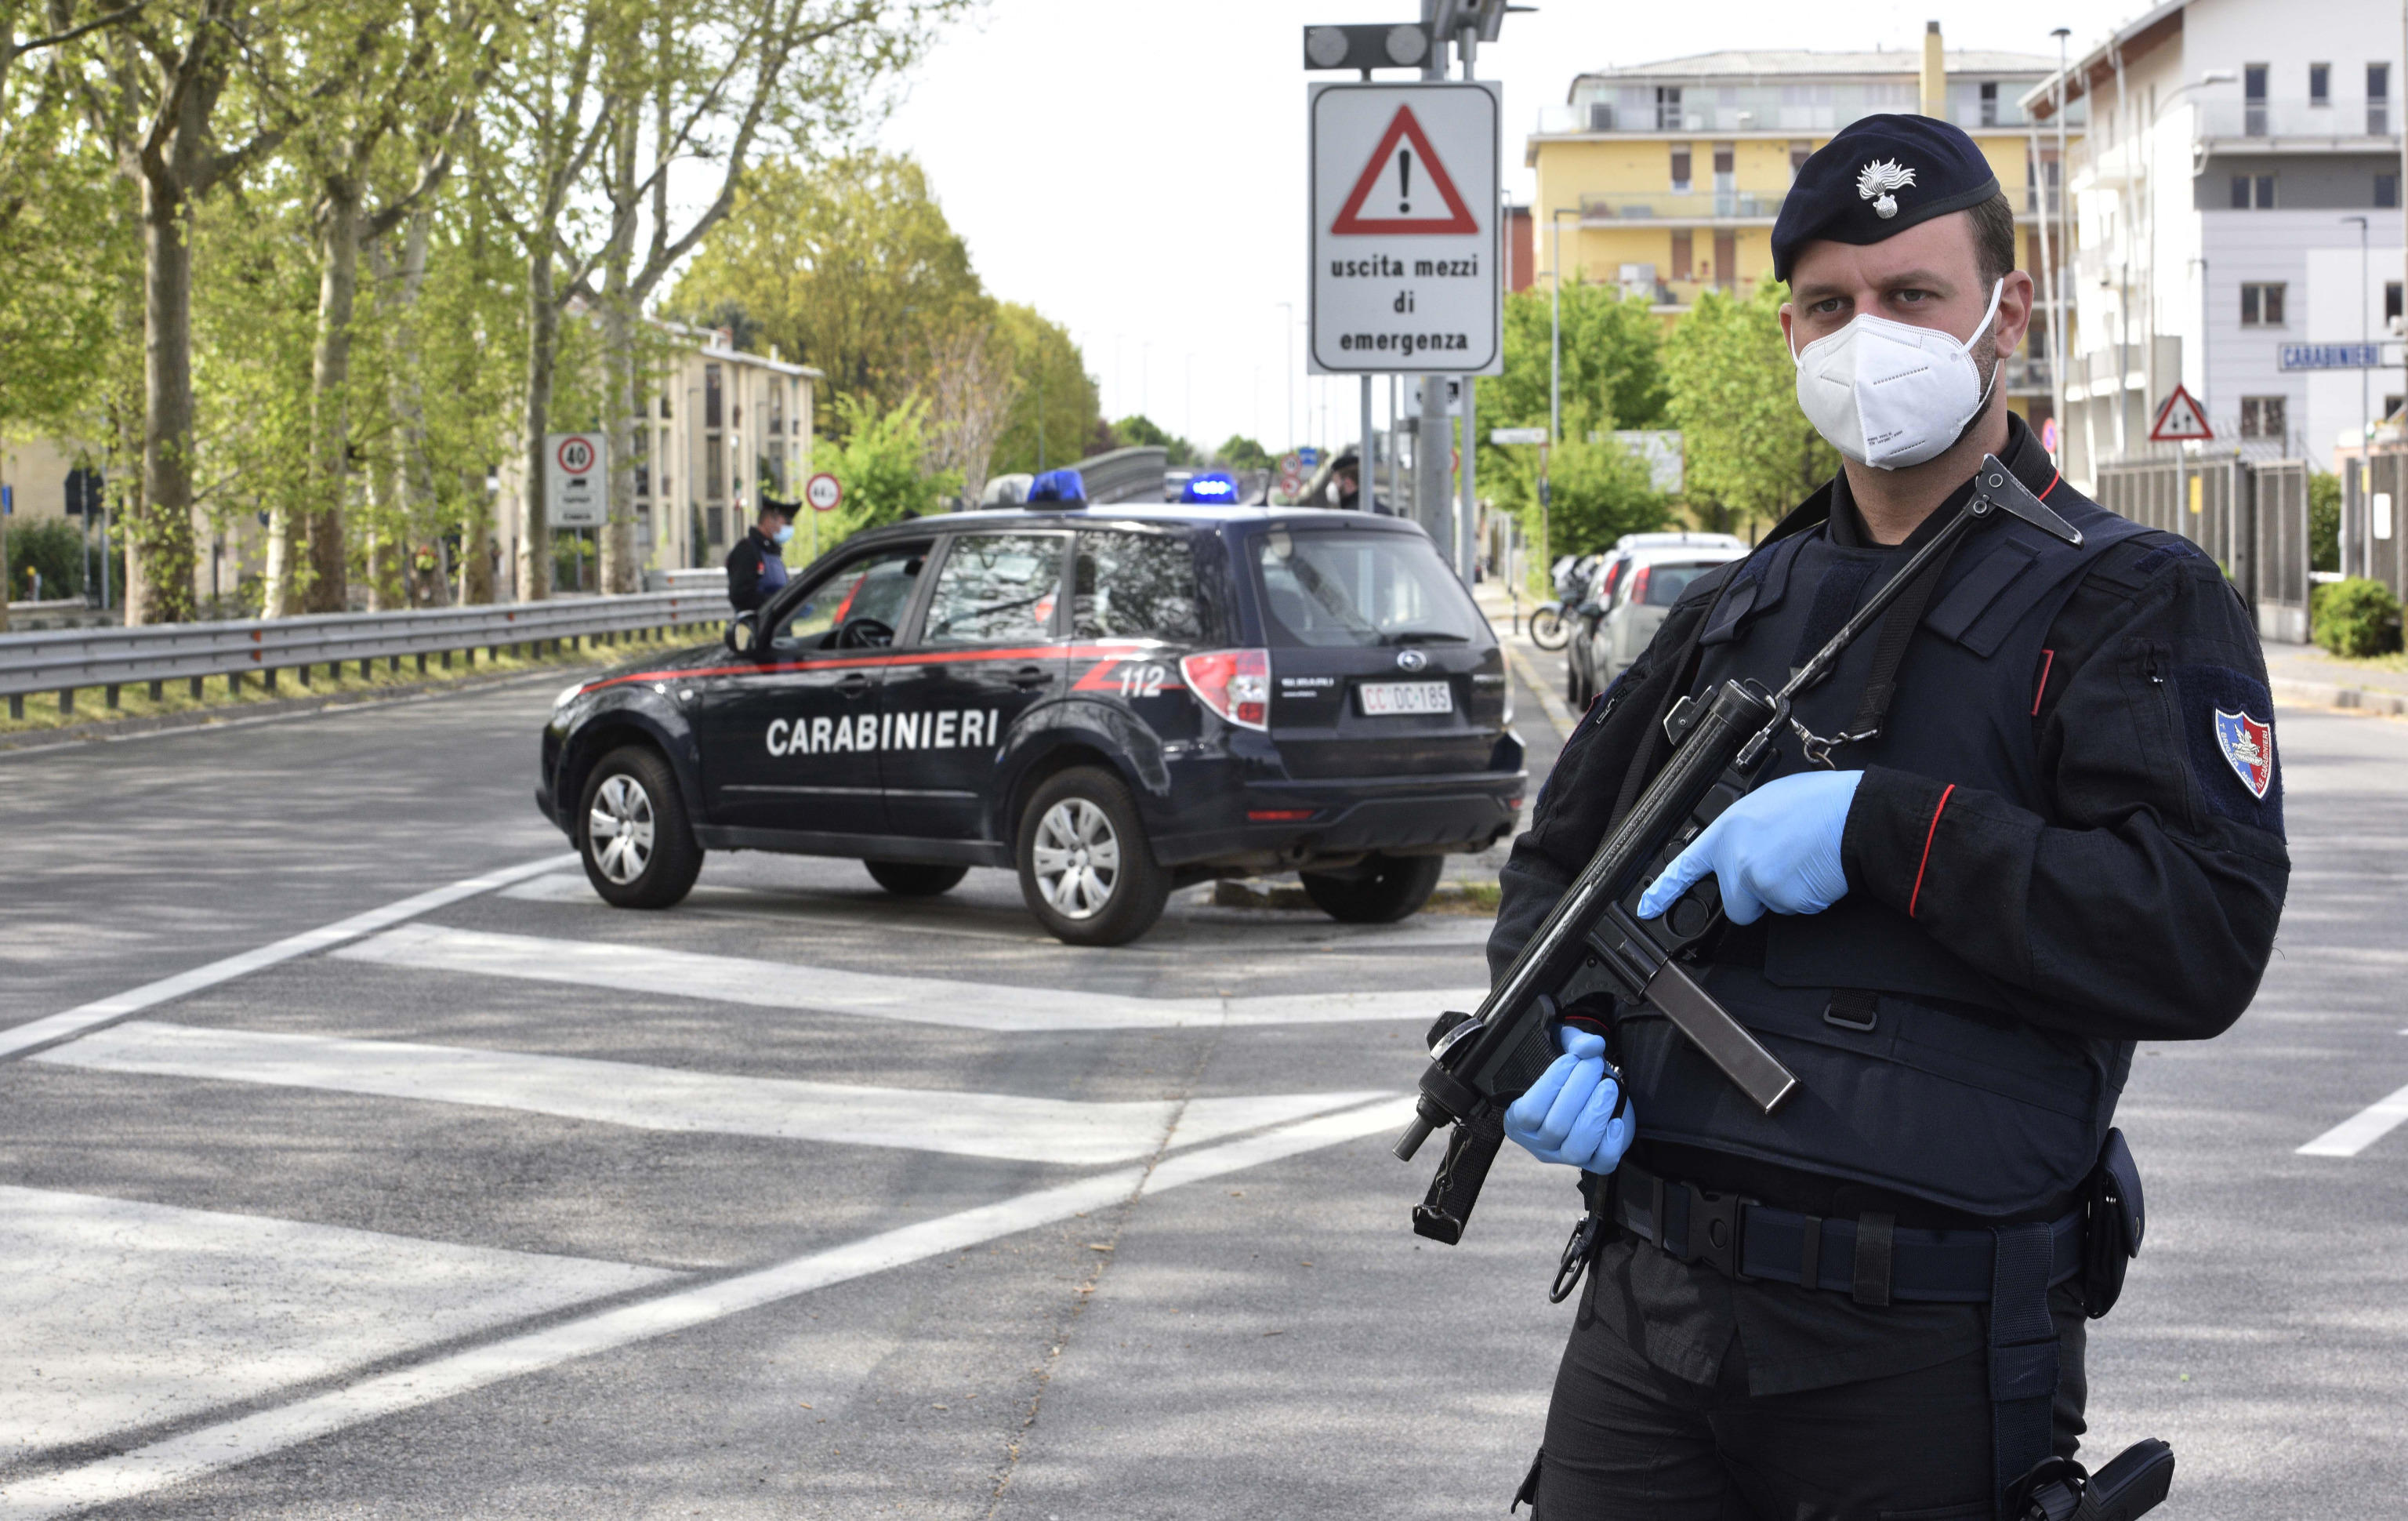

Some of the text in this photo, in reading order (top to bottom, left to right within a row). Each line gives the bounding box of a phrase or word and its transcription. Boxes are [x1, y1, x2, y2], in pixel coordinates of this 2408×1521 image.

[1331, 253, 1478, 278] uscita mezzi
[1393, 289, 1414, 314] di
[1340, 333, 1468, 355] emergenza
[2283, 344, 2378, 368] CARABINIERI
[566, 445, 586, 465] 40
[1119, 665, 1166, 698] 112
[766, 708, 999, 757] CARABINIERI
[2221, 731, 2239, 768] BRIGATA
